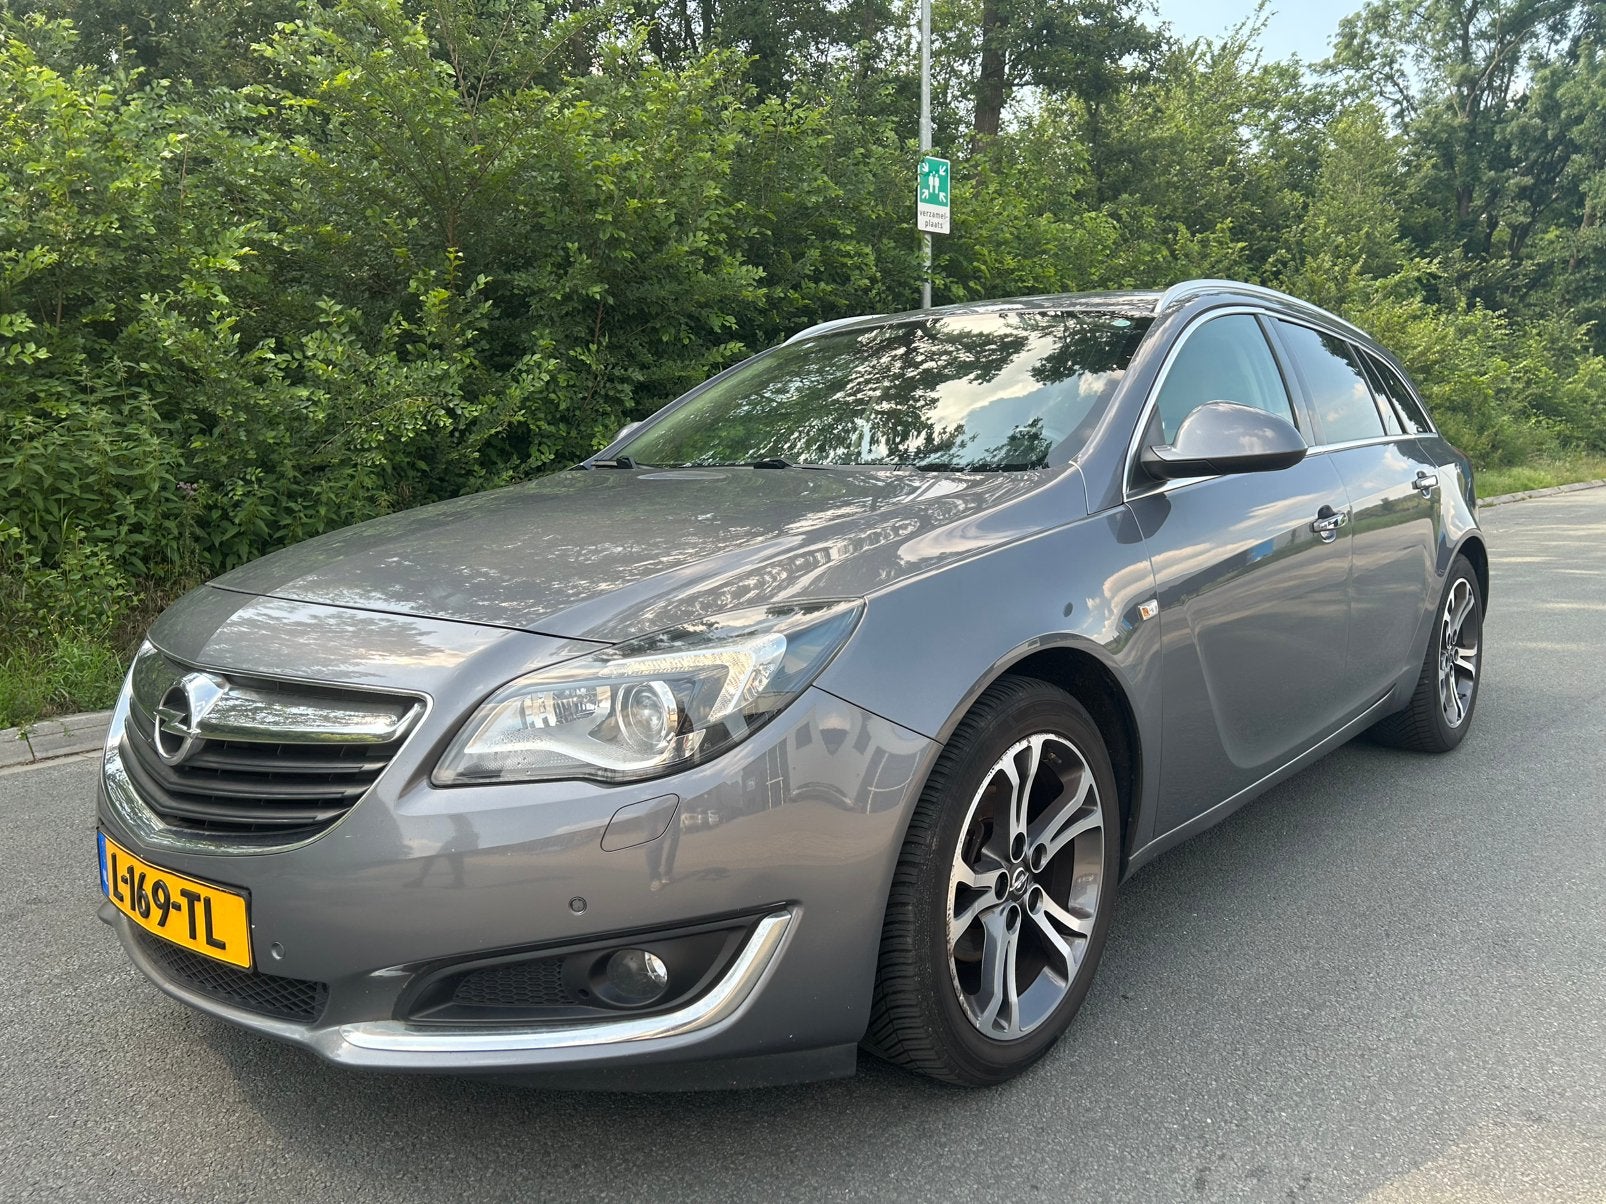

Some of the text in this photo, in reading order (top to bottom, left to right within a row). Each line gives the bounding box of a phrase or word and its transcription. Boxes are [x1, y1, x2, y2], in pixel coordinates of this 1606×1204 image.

[919, 210, 948, 220] verzamel-
[924, 220, 943, 229] plaats
[111, 852, 226, 950] L-169-TL
